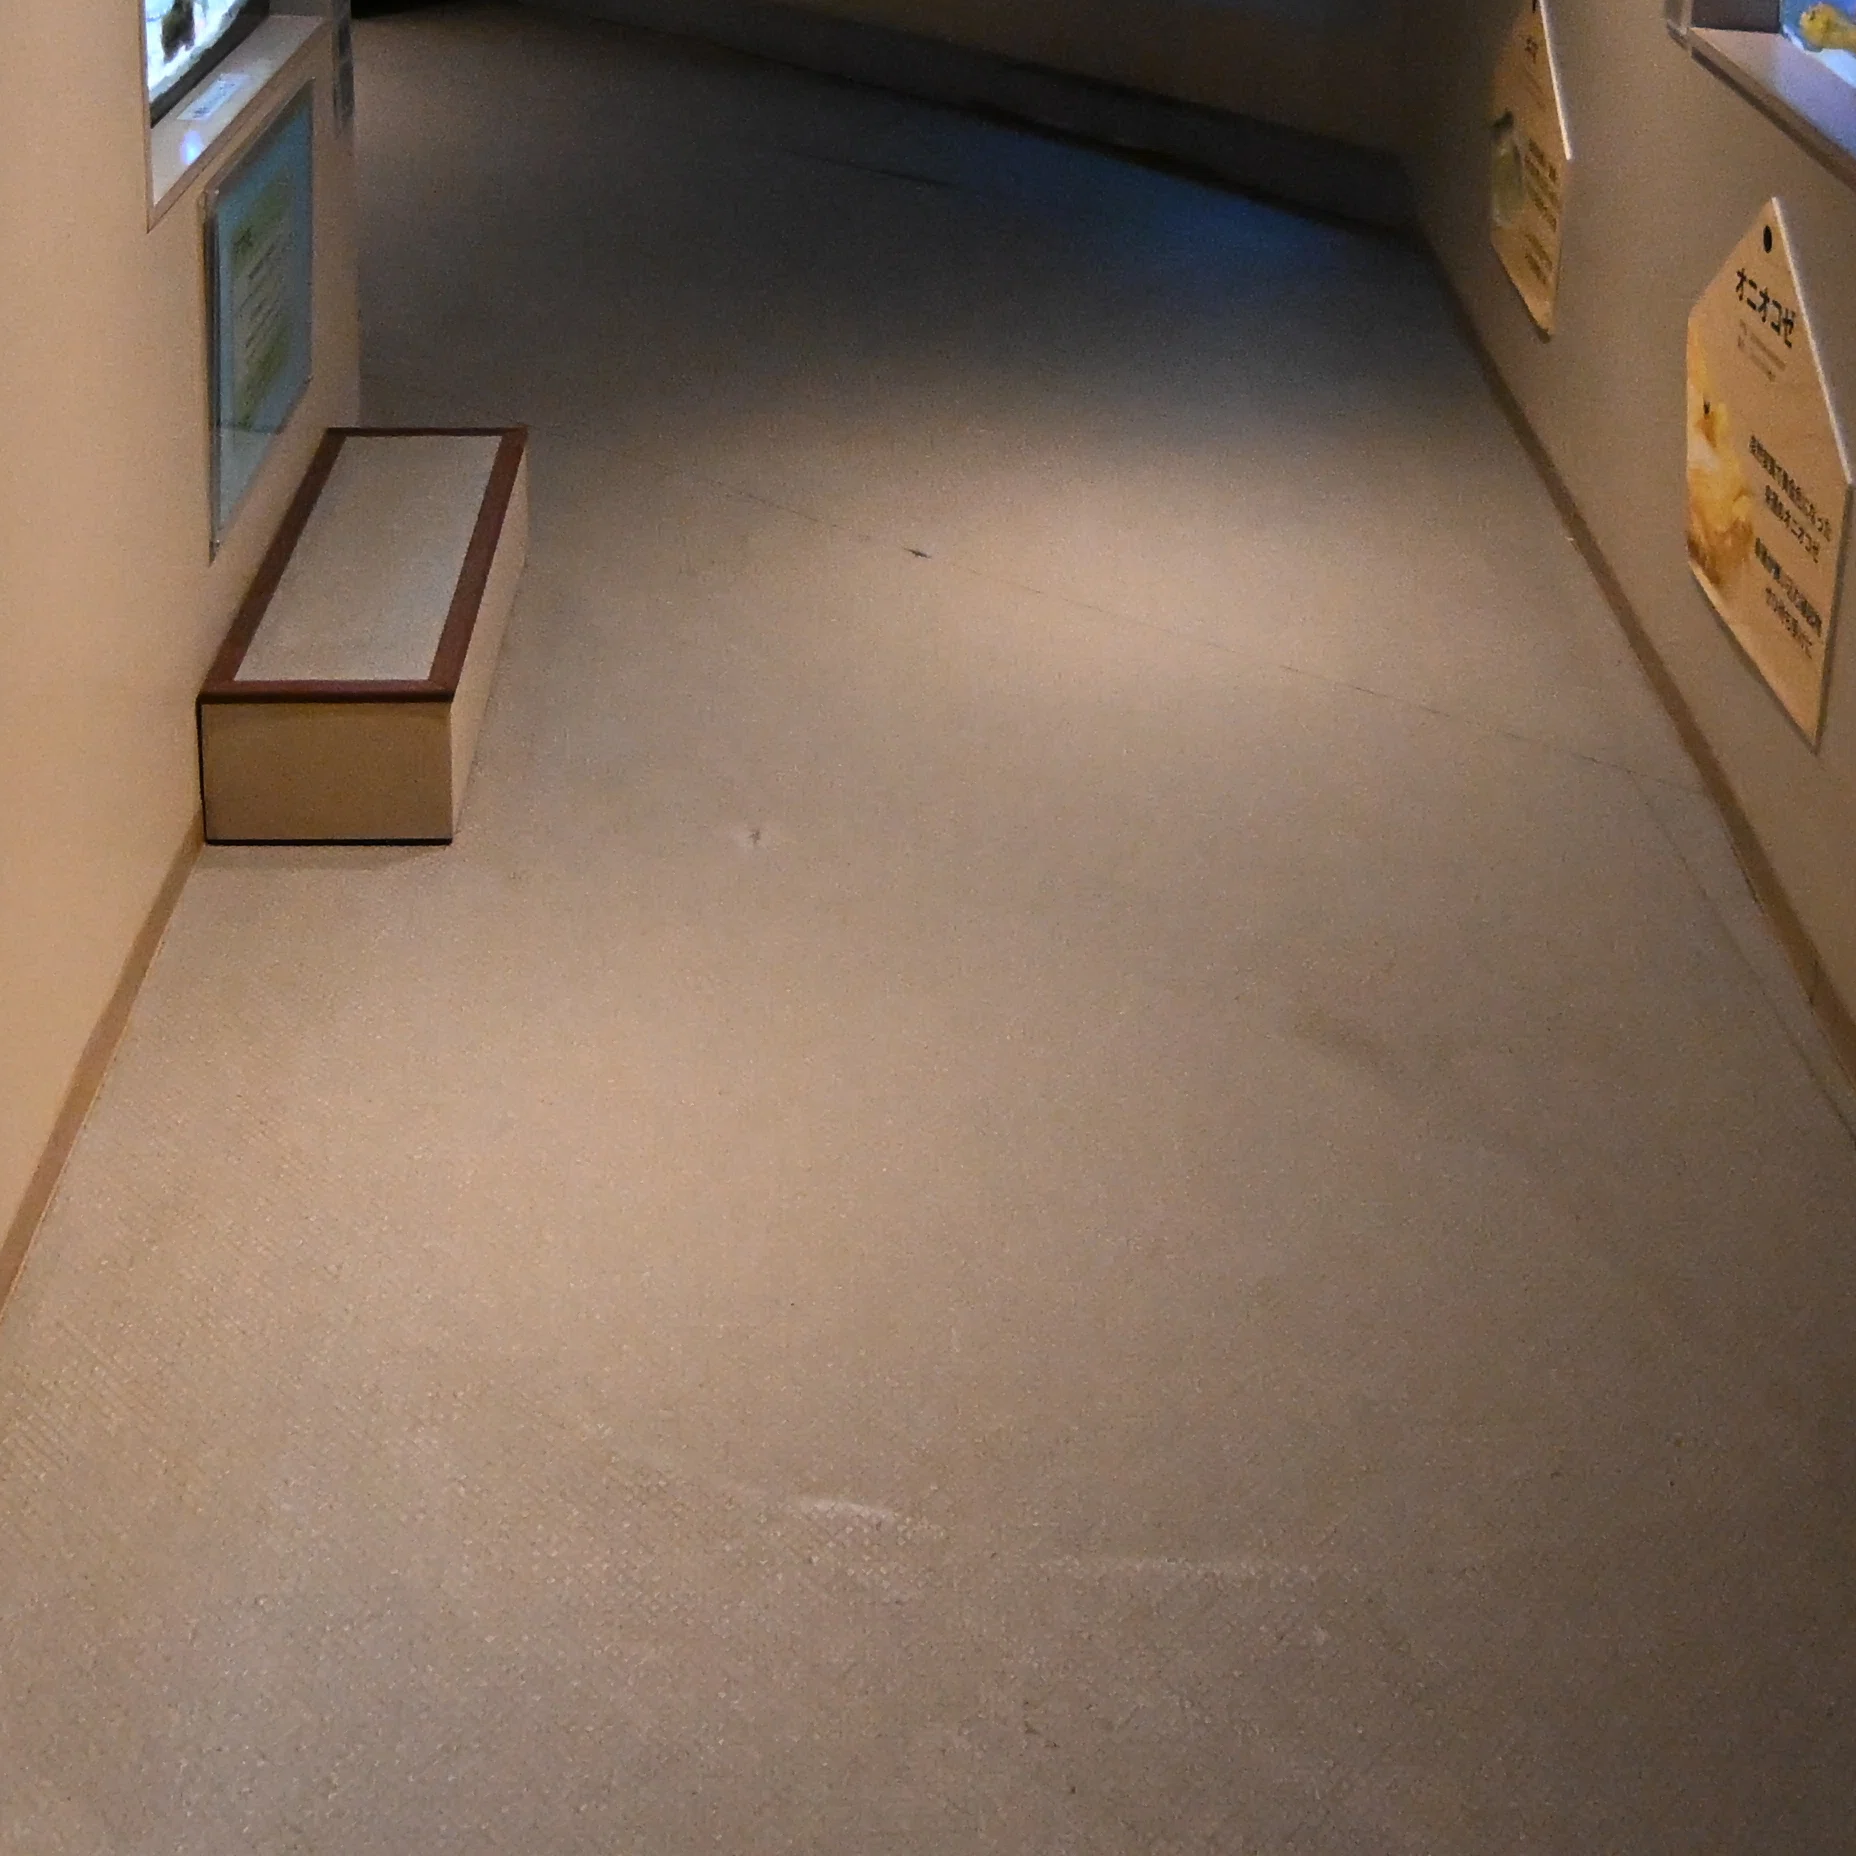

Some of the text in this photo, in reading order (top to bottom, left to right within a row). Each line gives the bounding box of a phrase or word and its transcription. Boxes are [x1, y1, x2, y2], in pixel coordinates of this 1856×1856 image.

[1735, 267, 1796, 348] オニオコゼ
